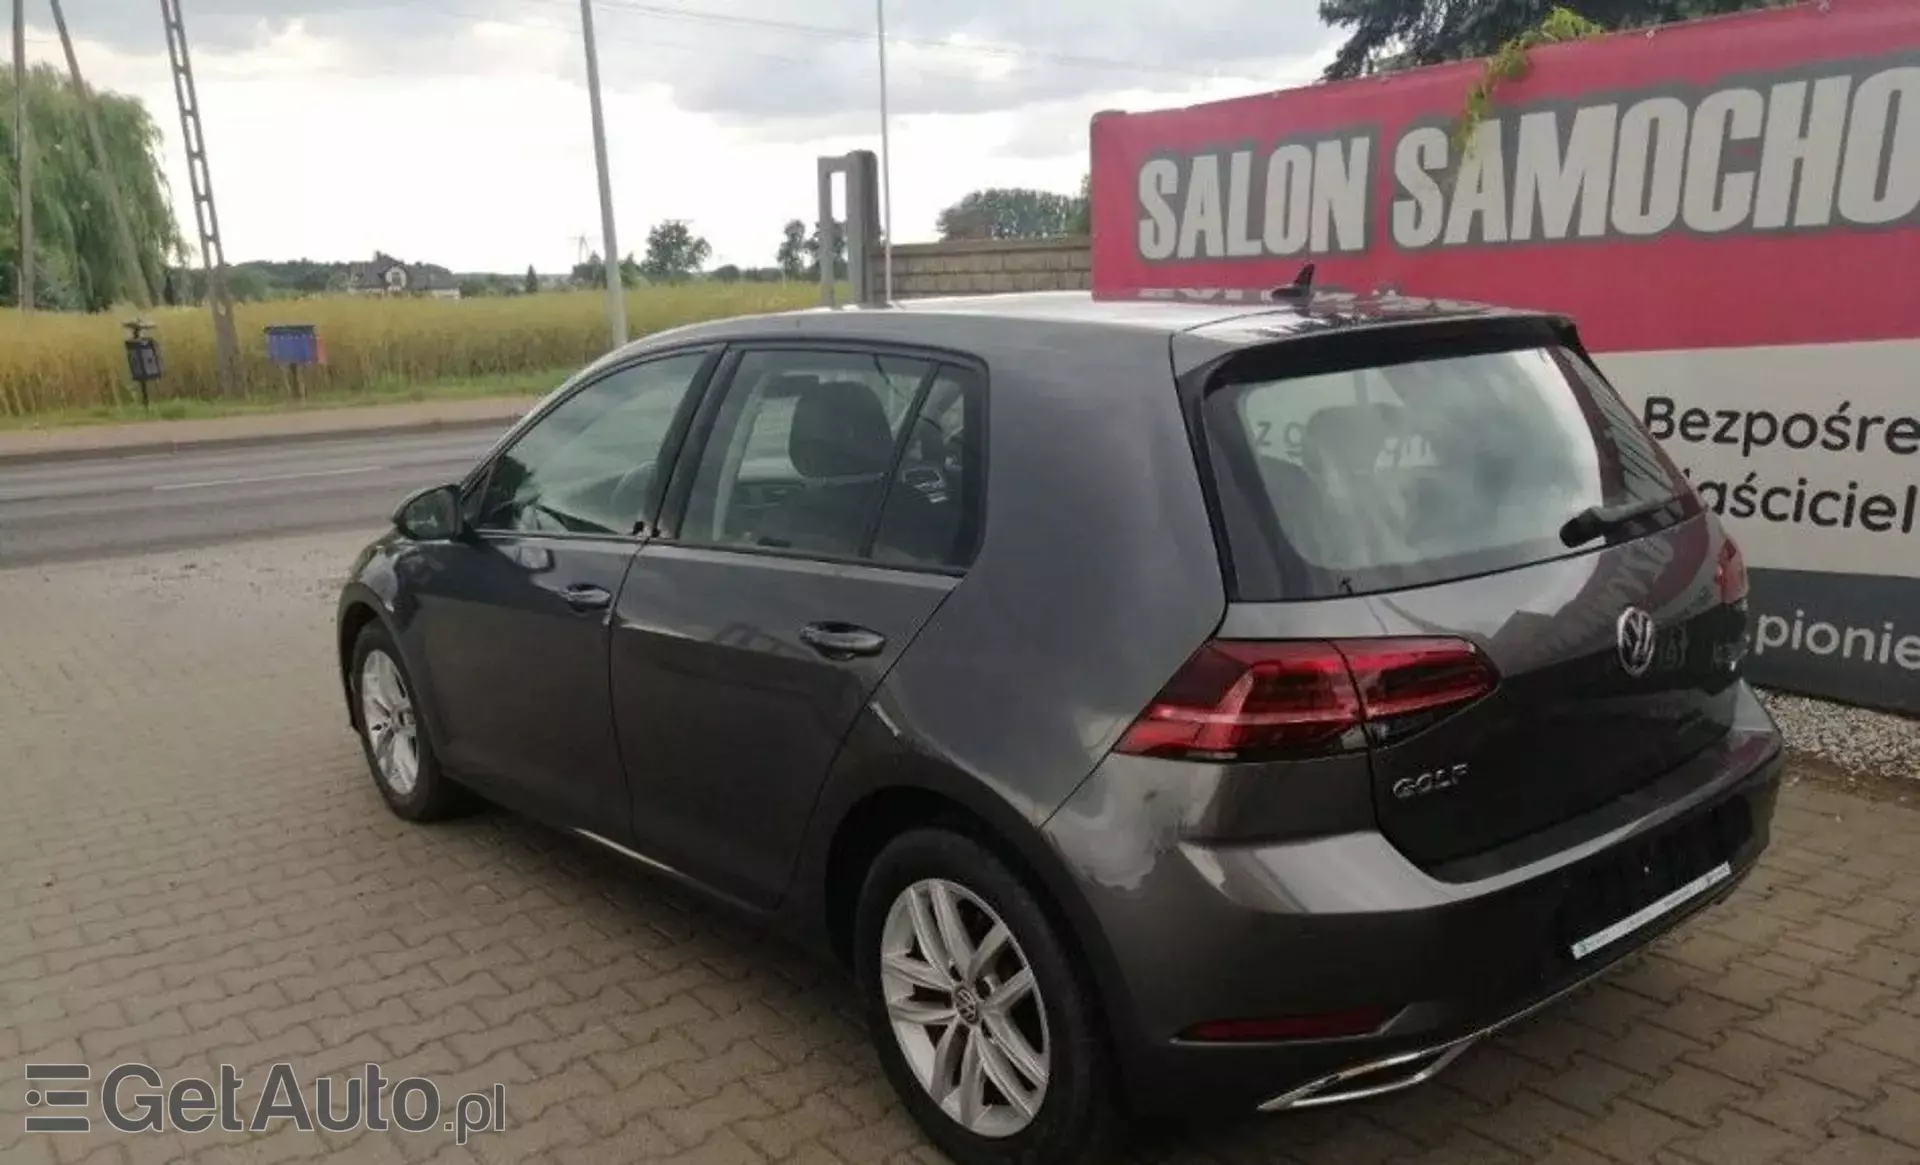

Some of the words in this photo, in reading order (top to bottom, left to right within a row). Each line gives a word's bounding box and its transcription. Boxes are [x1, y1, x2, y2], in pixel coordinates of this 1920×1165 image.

[1138, 136, 1369, 260] SALON
[1392, 66, 1920, 250] SAMOCHO
[1644, 395, 1920, 458] Bezpośre
[1392, 762, 1470, 799] GOLF
